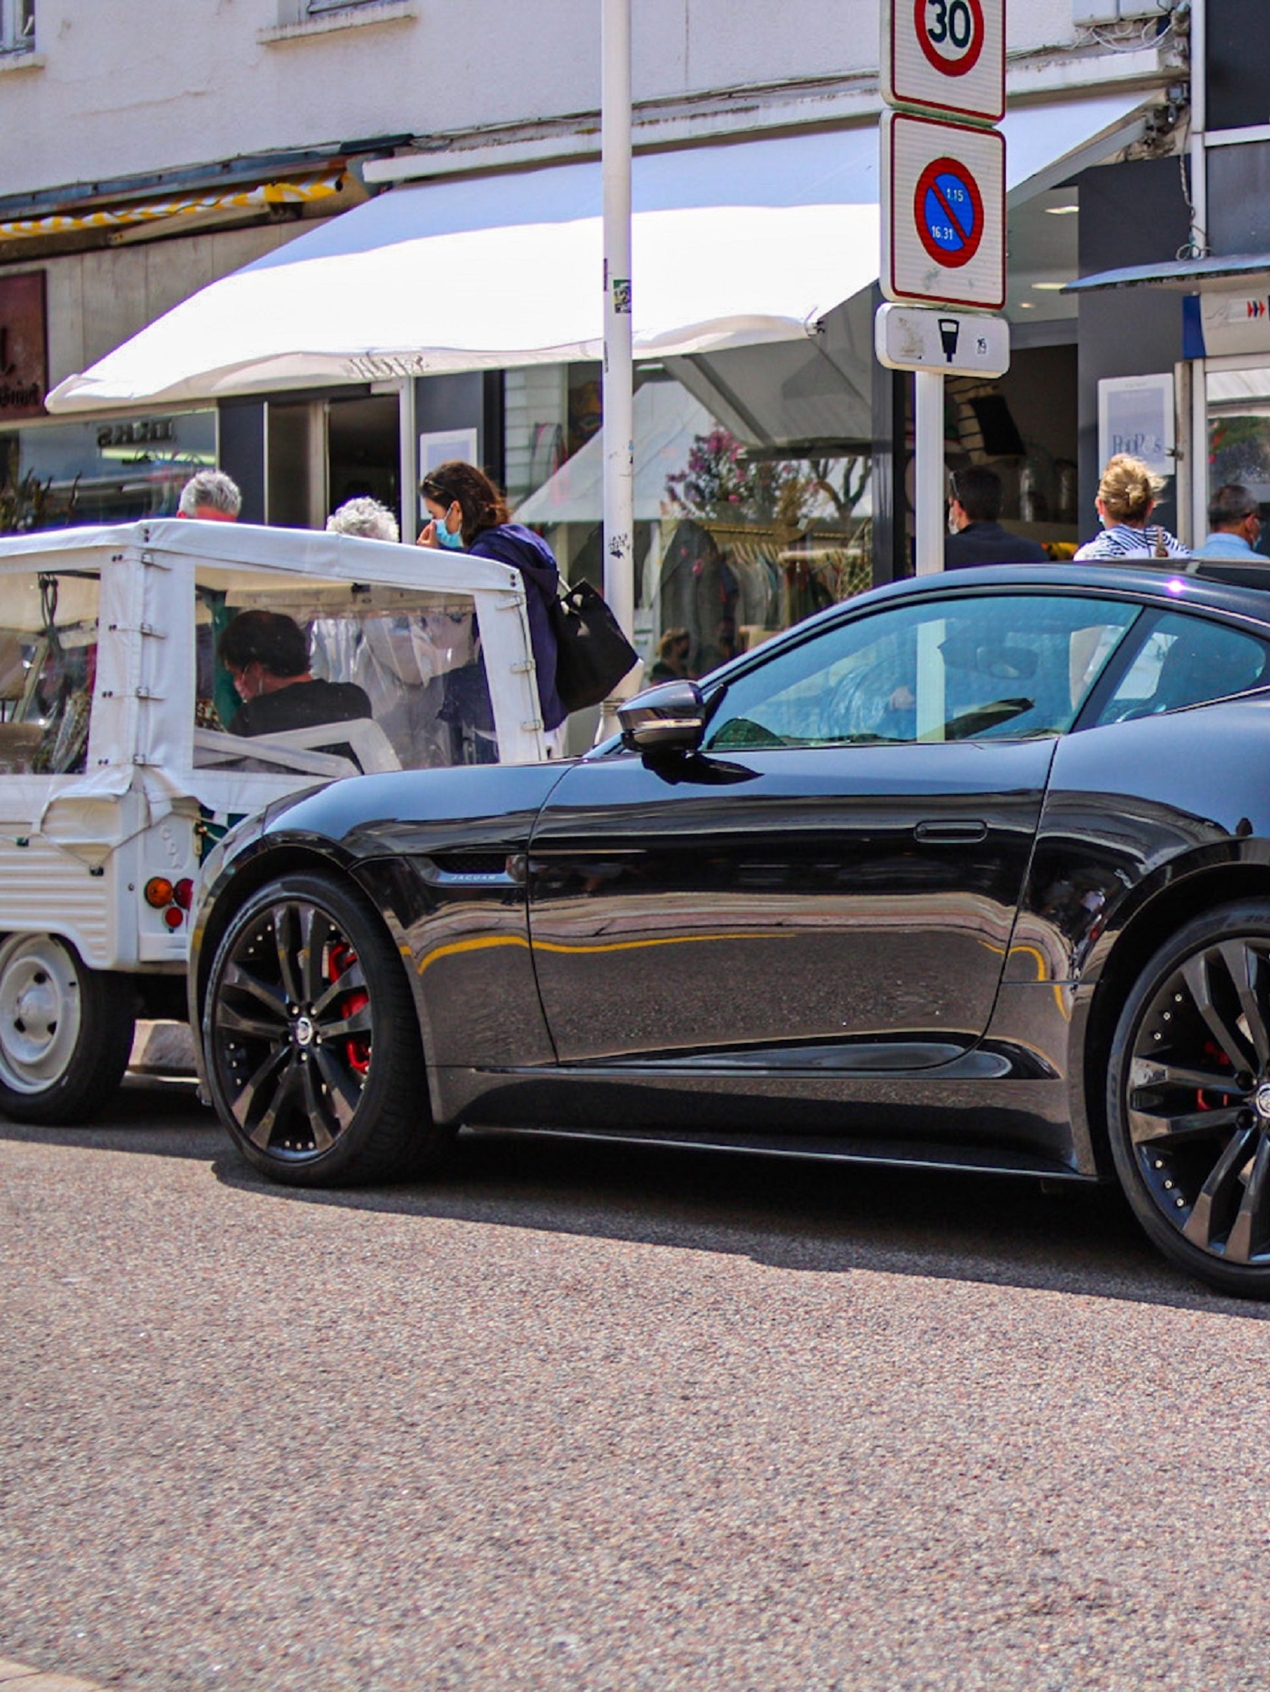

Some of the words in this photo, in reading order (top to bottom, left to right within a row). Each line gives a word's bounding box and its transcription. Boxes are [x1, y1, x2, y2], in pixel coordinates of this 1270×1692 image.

[927, 0, 971, 48] 30
[946, 187, 964, 202] 1.15
[931, 225, 953, 240] 16.31
